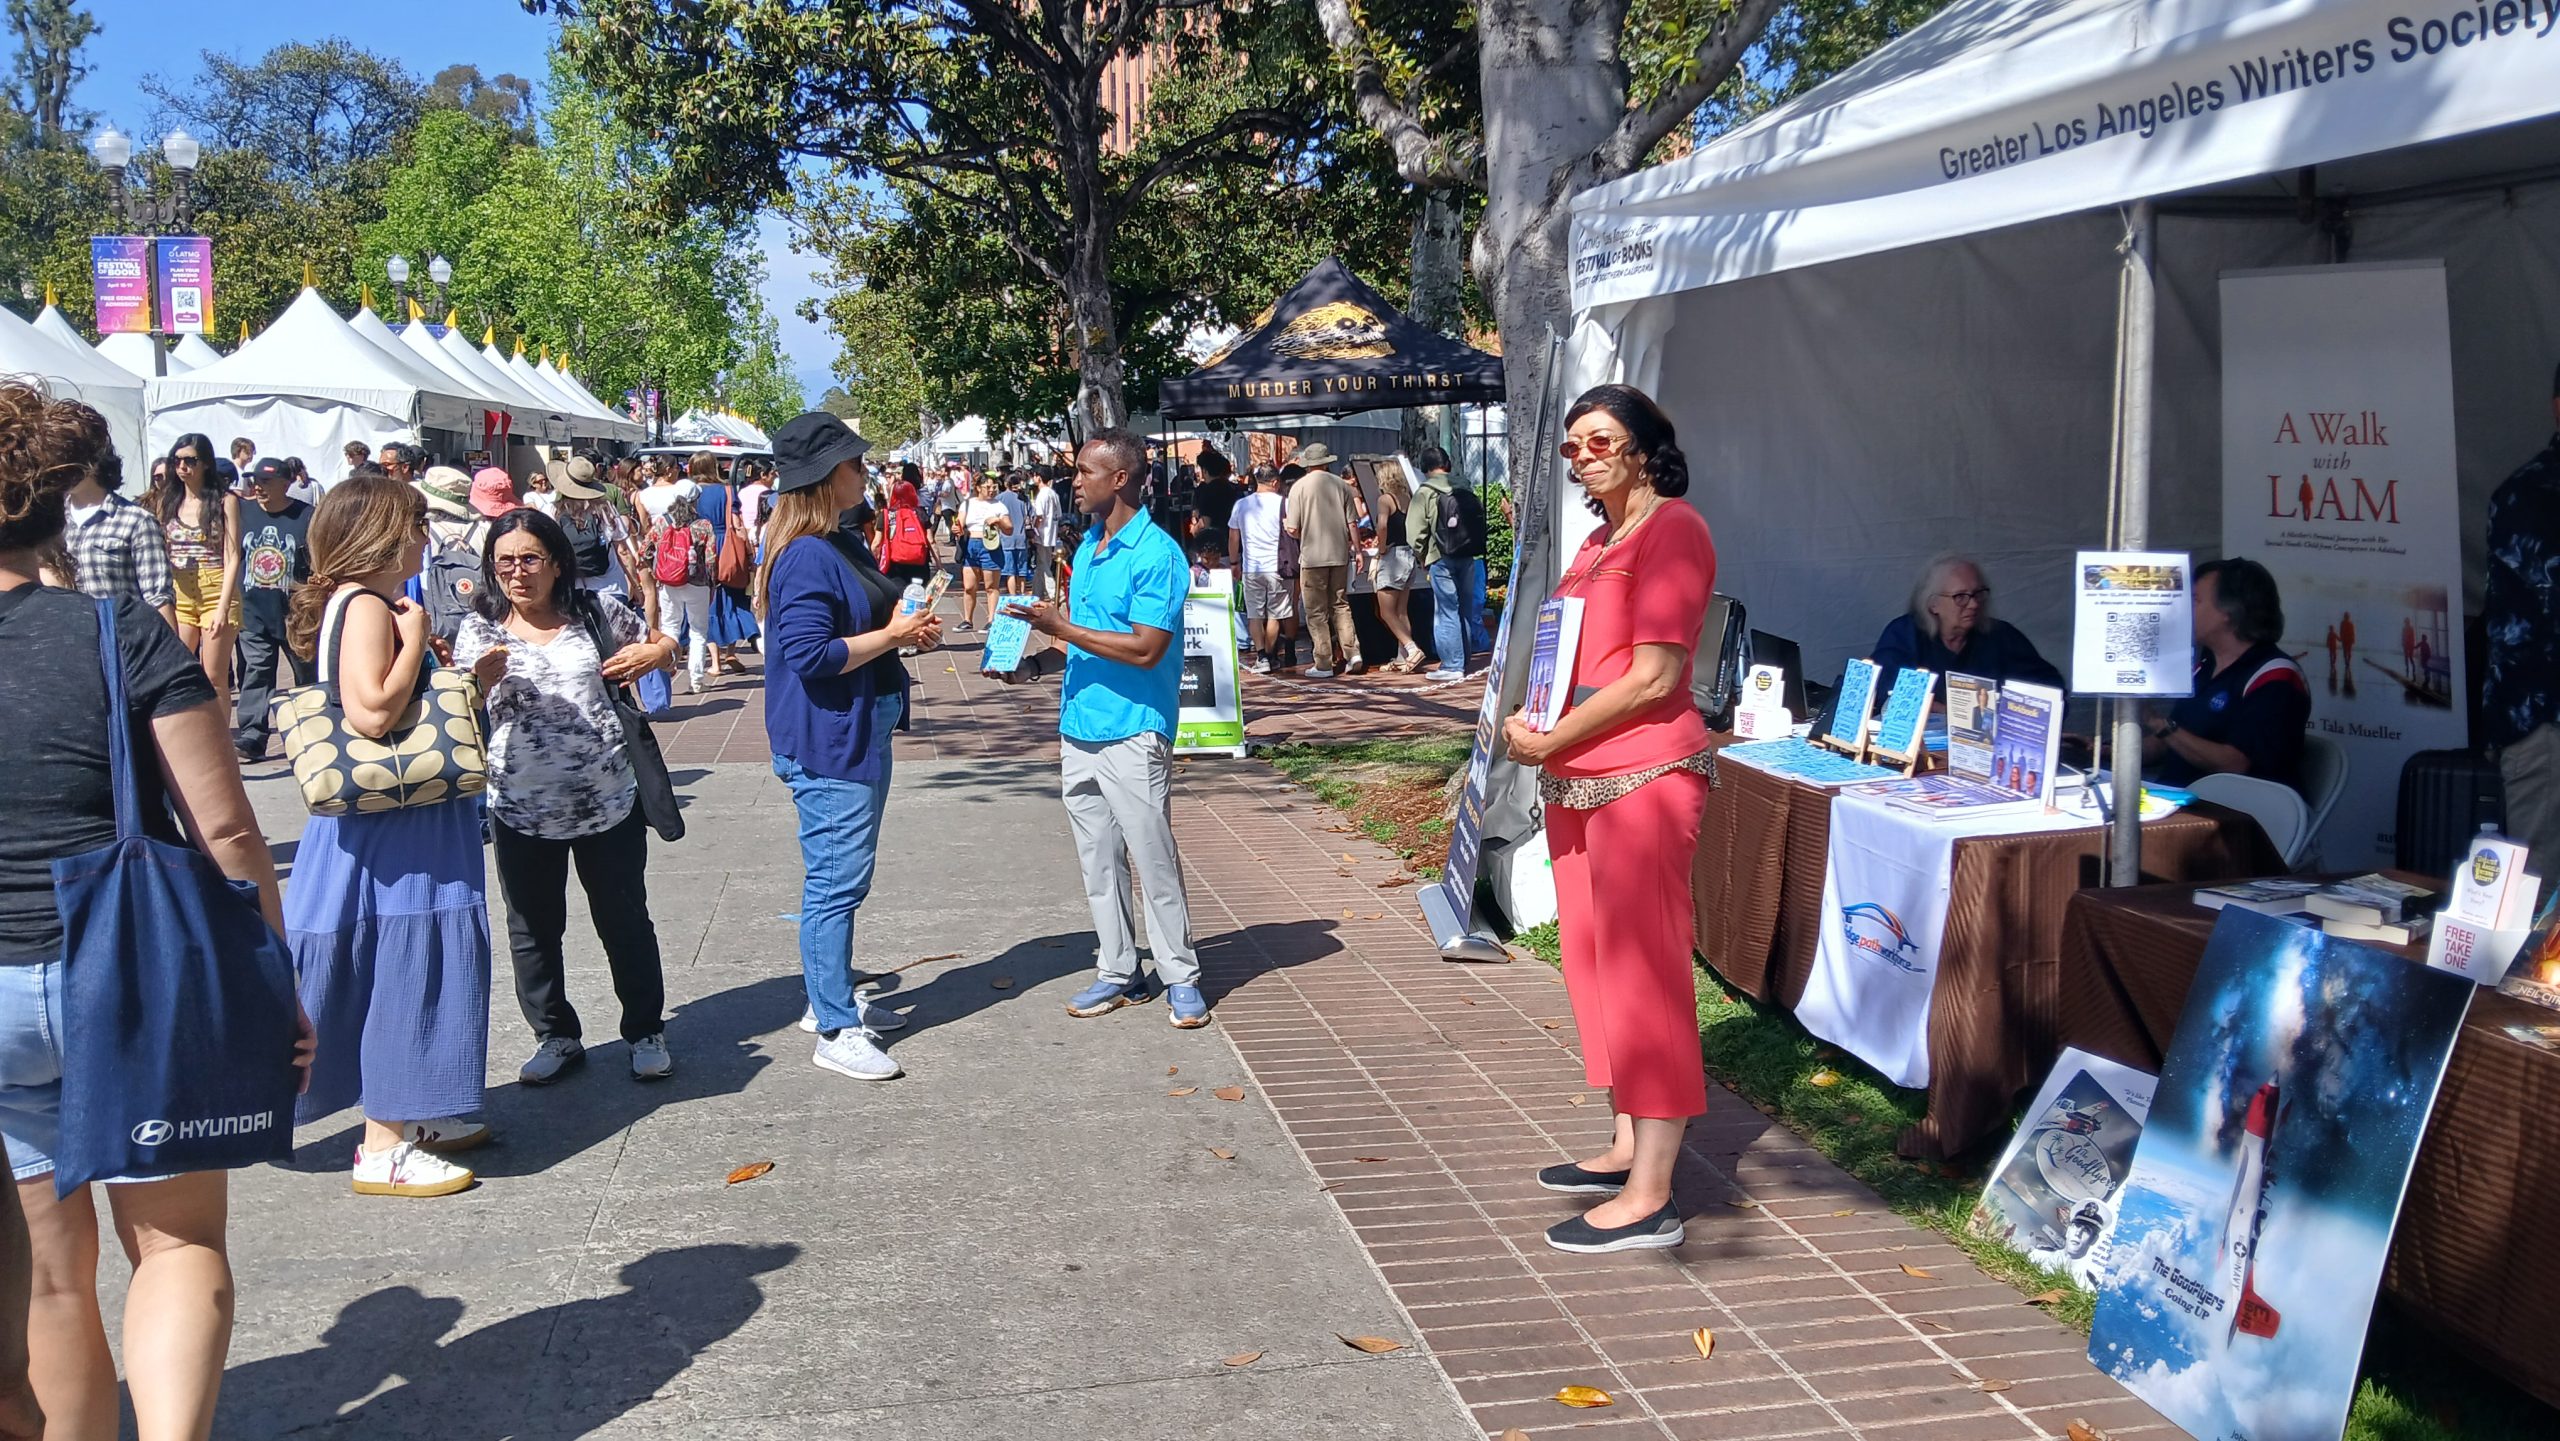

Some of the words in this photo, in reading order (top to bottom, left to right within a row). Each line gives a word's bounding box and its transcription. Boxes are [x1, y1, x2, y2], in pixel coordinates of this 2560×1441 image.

[1940, 132, 2028, 179] Greater
[2032, 122, 2087, 155] Los
[2097, 80, 2225, 140] Angeles
[2229, 39, 2375, 102] Writers
[2387, 0, 2560, 63] Society
[1612, 251, 1621, 264] OF
[1621, 239, 1653, 265] BOOKS
[97, 261, 141, 270] FESTIVAL
[108, 269, 141, 277] BOOKS
[1229, 380, 1313, 399] MURDER
[1324, 376, 1378, 392] YOUR
[1389, 373, 1464, 389] THIRST
[2274, 412, 2301, 444] A
[2308, 410, 2389, 446] Walk
[2313, 451, 2351, 470] with
[1184, 624, 1209, 636] mni
[1184, 637, 1202, 649] rk
[2319, 718, 2345, 734] Tala
[2348, 723, 2402, 740] Mueller
[2445, 925, 2476, 946] FREE!
[2445, 939, 2472, 958] TAKE
[2444, 953, 2468, 971] ONE
[2519, 985, 2540, 999] NEIL
[179, 1110, 273, 1140] HYUNDAI
[2152, 1256, 2170, 1278] The
[2232, 1264, 2244, 1292] NAVY
[2170, 1267, 2225, 1312] Goodflyers
[2194, 1306, 2210, 1320] UP
